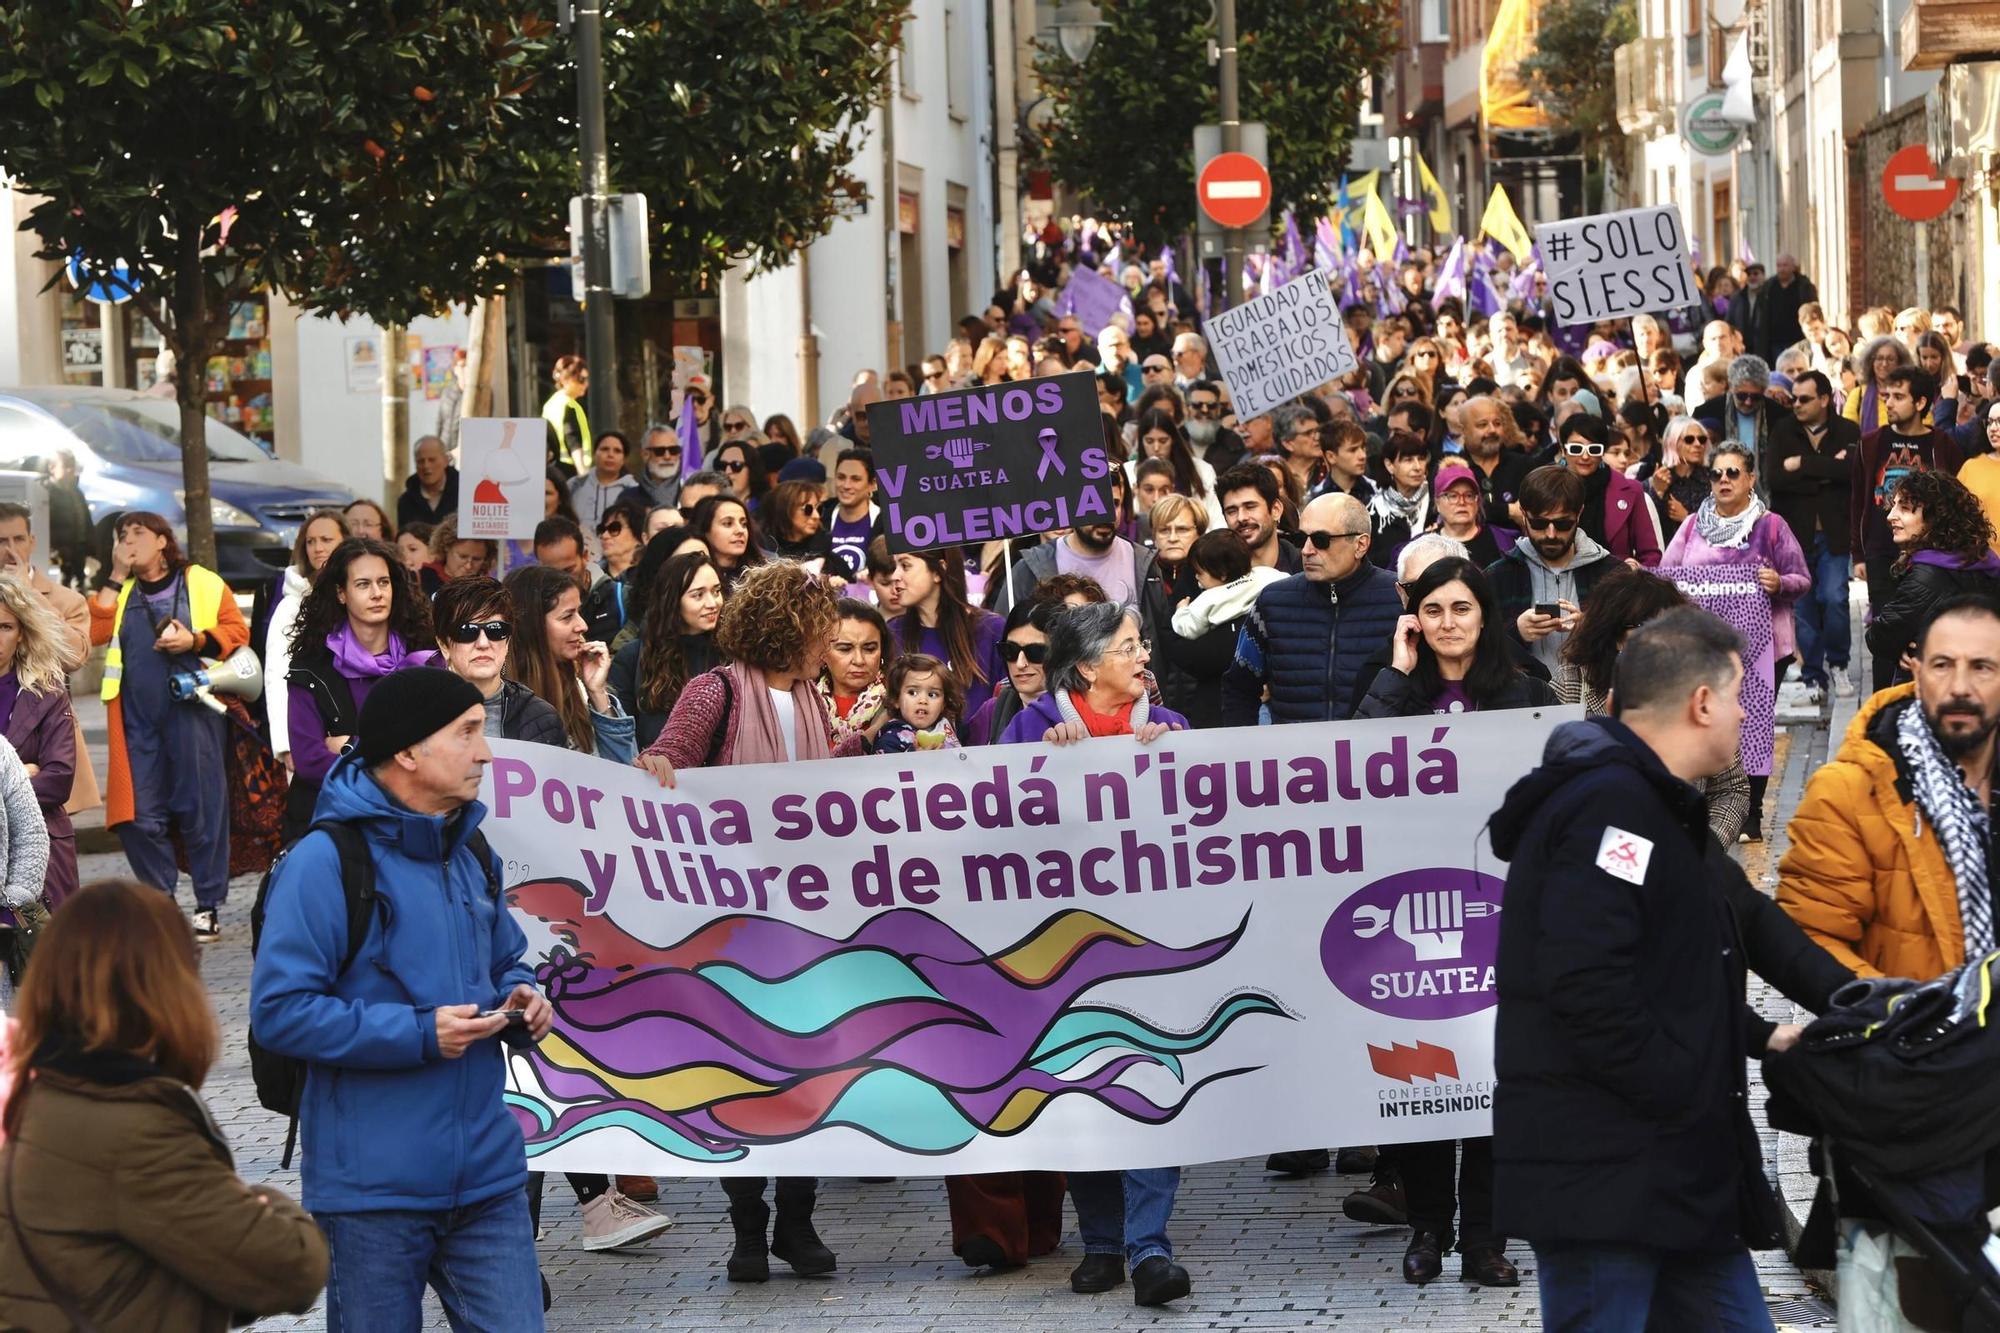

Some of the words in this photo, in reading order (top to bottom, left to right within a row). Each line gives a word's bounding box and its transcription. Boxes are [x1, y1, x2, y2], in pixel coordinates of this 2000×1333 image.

[1210, 284, 1300, 343] IGUALDAD
[1305, 272, 1329, 297] EN
[1221, 298, 1332, 363] TRABAJOS
[1227, 328, 1327, 391] DOMESTICOS
[1328, 318, 1341, 342] Y
[1236, 389, 1259, 415] DE
[1263, 344, 1354, 403] CUIDADOS
[900, 382, 1064, 435] MENOS
[919, 468, 1010, 493] SUATEA
[472, 504, 509, 517] NOLITE
[1676, 580, 1757, 596] Podemos
[491, 757, 605, 830] Por
[622, 795, 753, 846] una
[771, 755, 1061, 841] sociedá
[579, 848, 617, 913] y
[631, 845, 830, 912] llibre
[851, 844, 942, 909] de
[961, 825, 1364, 902] machismu
[1370, 965, 1498, 1000] SUATEA
[1380, 1094, 1494, 1118] INTERSINDIC
